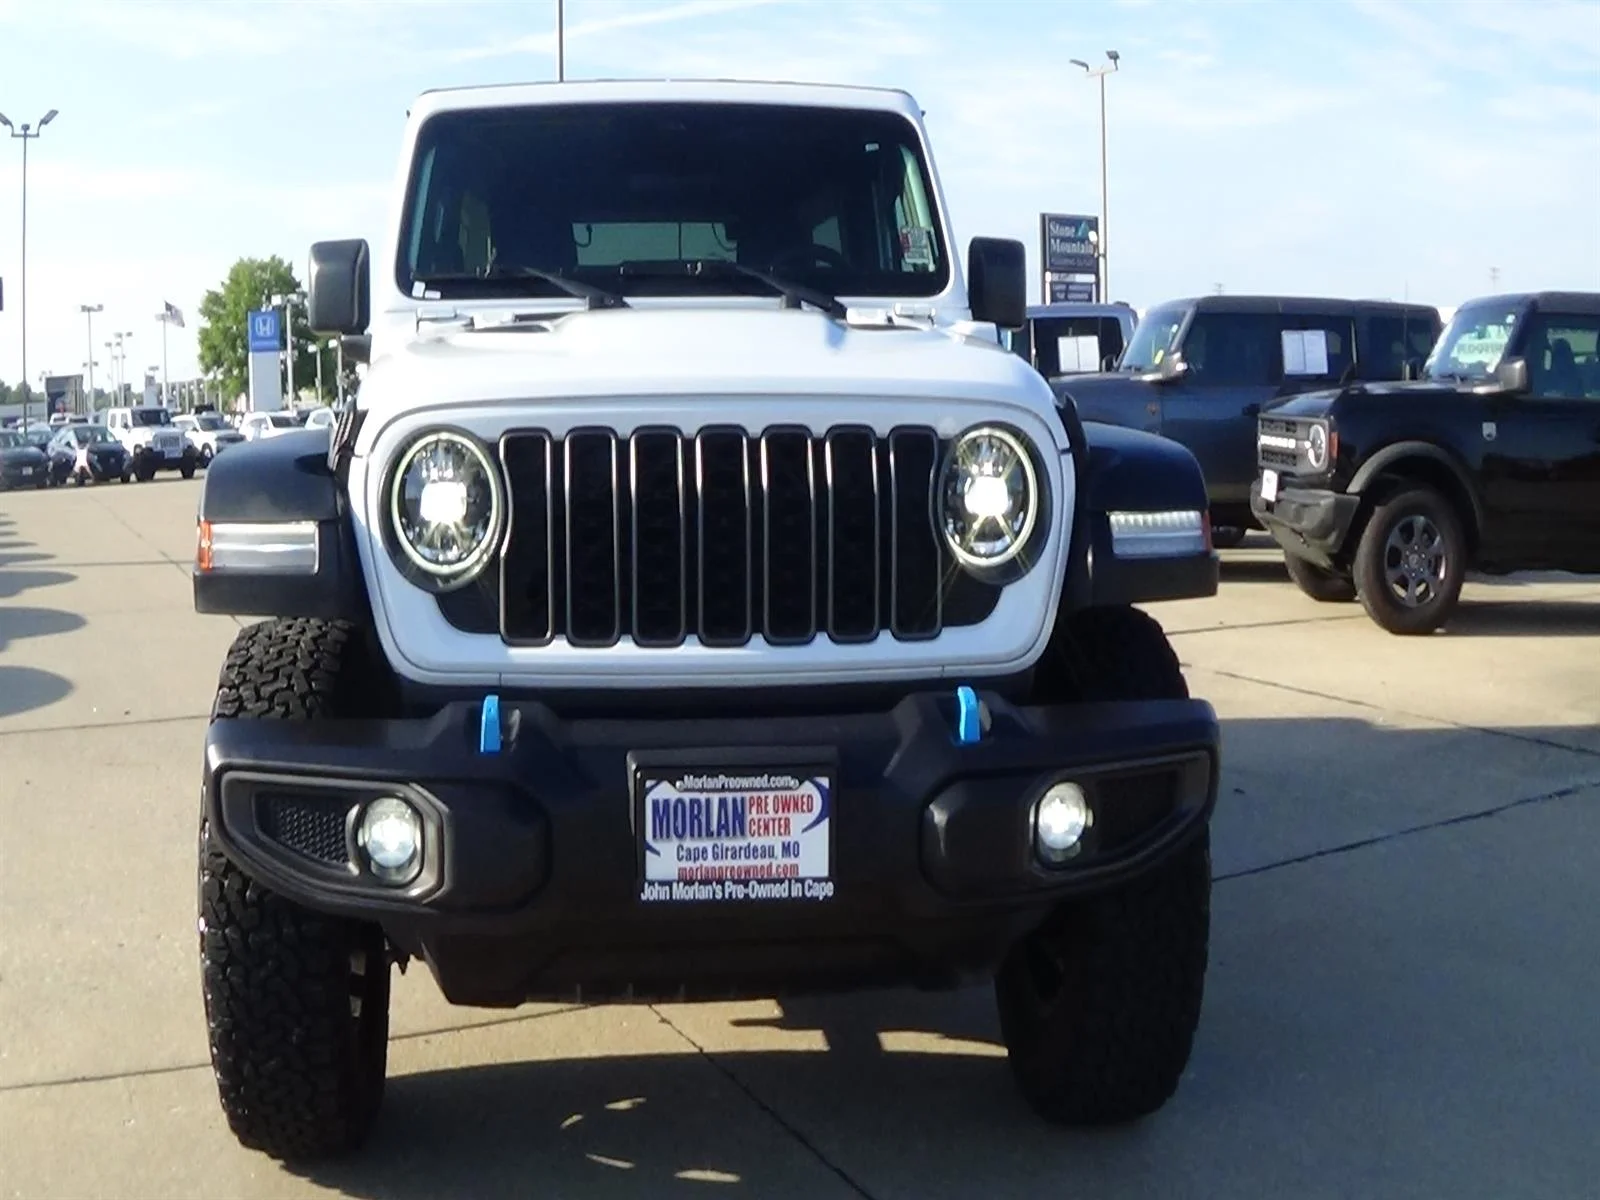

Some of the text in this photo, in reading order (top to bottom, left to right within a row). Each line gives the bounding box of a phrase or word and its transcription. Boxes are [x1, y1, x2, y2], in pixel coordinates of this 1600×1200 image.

[683, 774, 792, 790] MorlanPreowned.com
[748, 794, 814, 815] PRE OWNED
[652, 796, 745, 839] MORLAN
[748, 817, 791, 837] CENTER
[676, 844, 708, 863] Cape
[781, 841, 800, 859] MO
[678, 862, 800, 881] morlanpreowned.com
[641, 879, 834, 900] John Morlan's Pre-Owned in Cape
